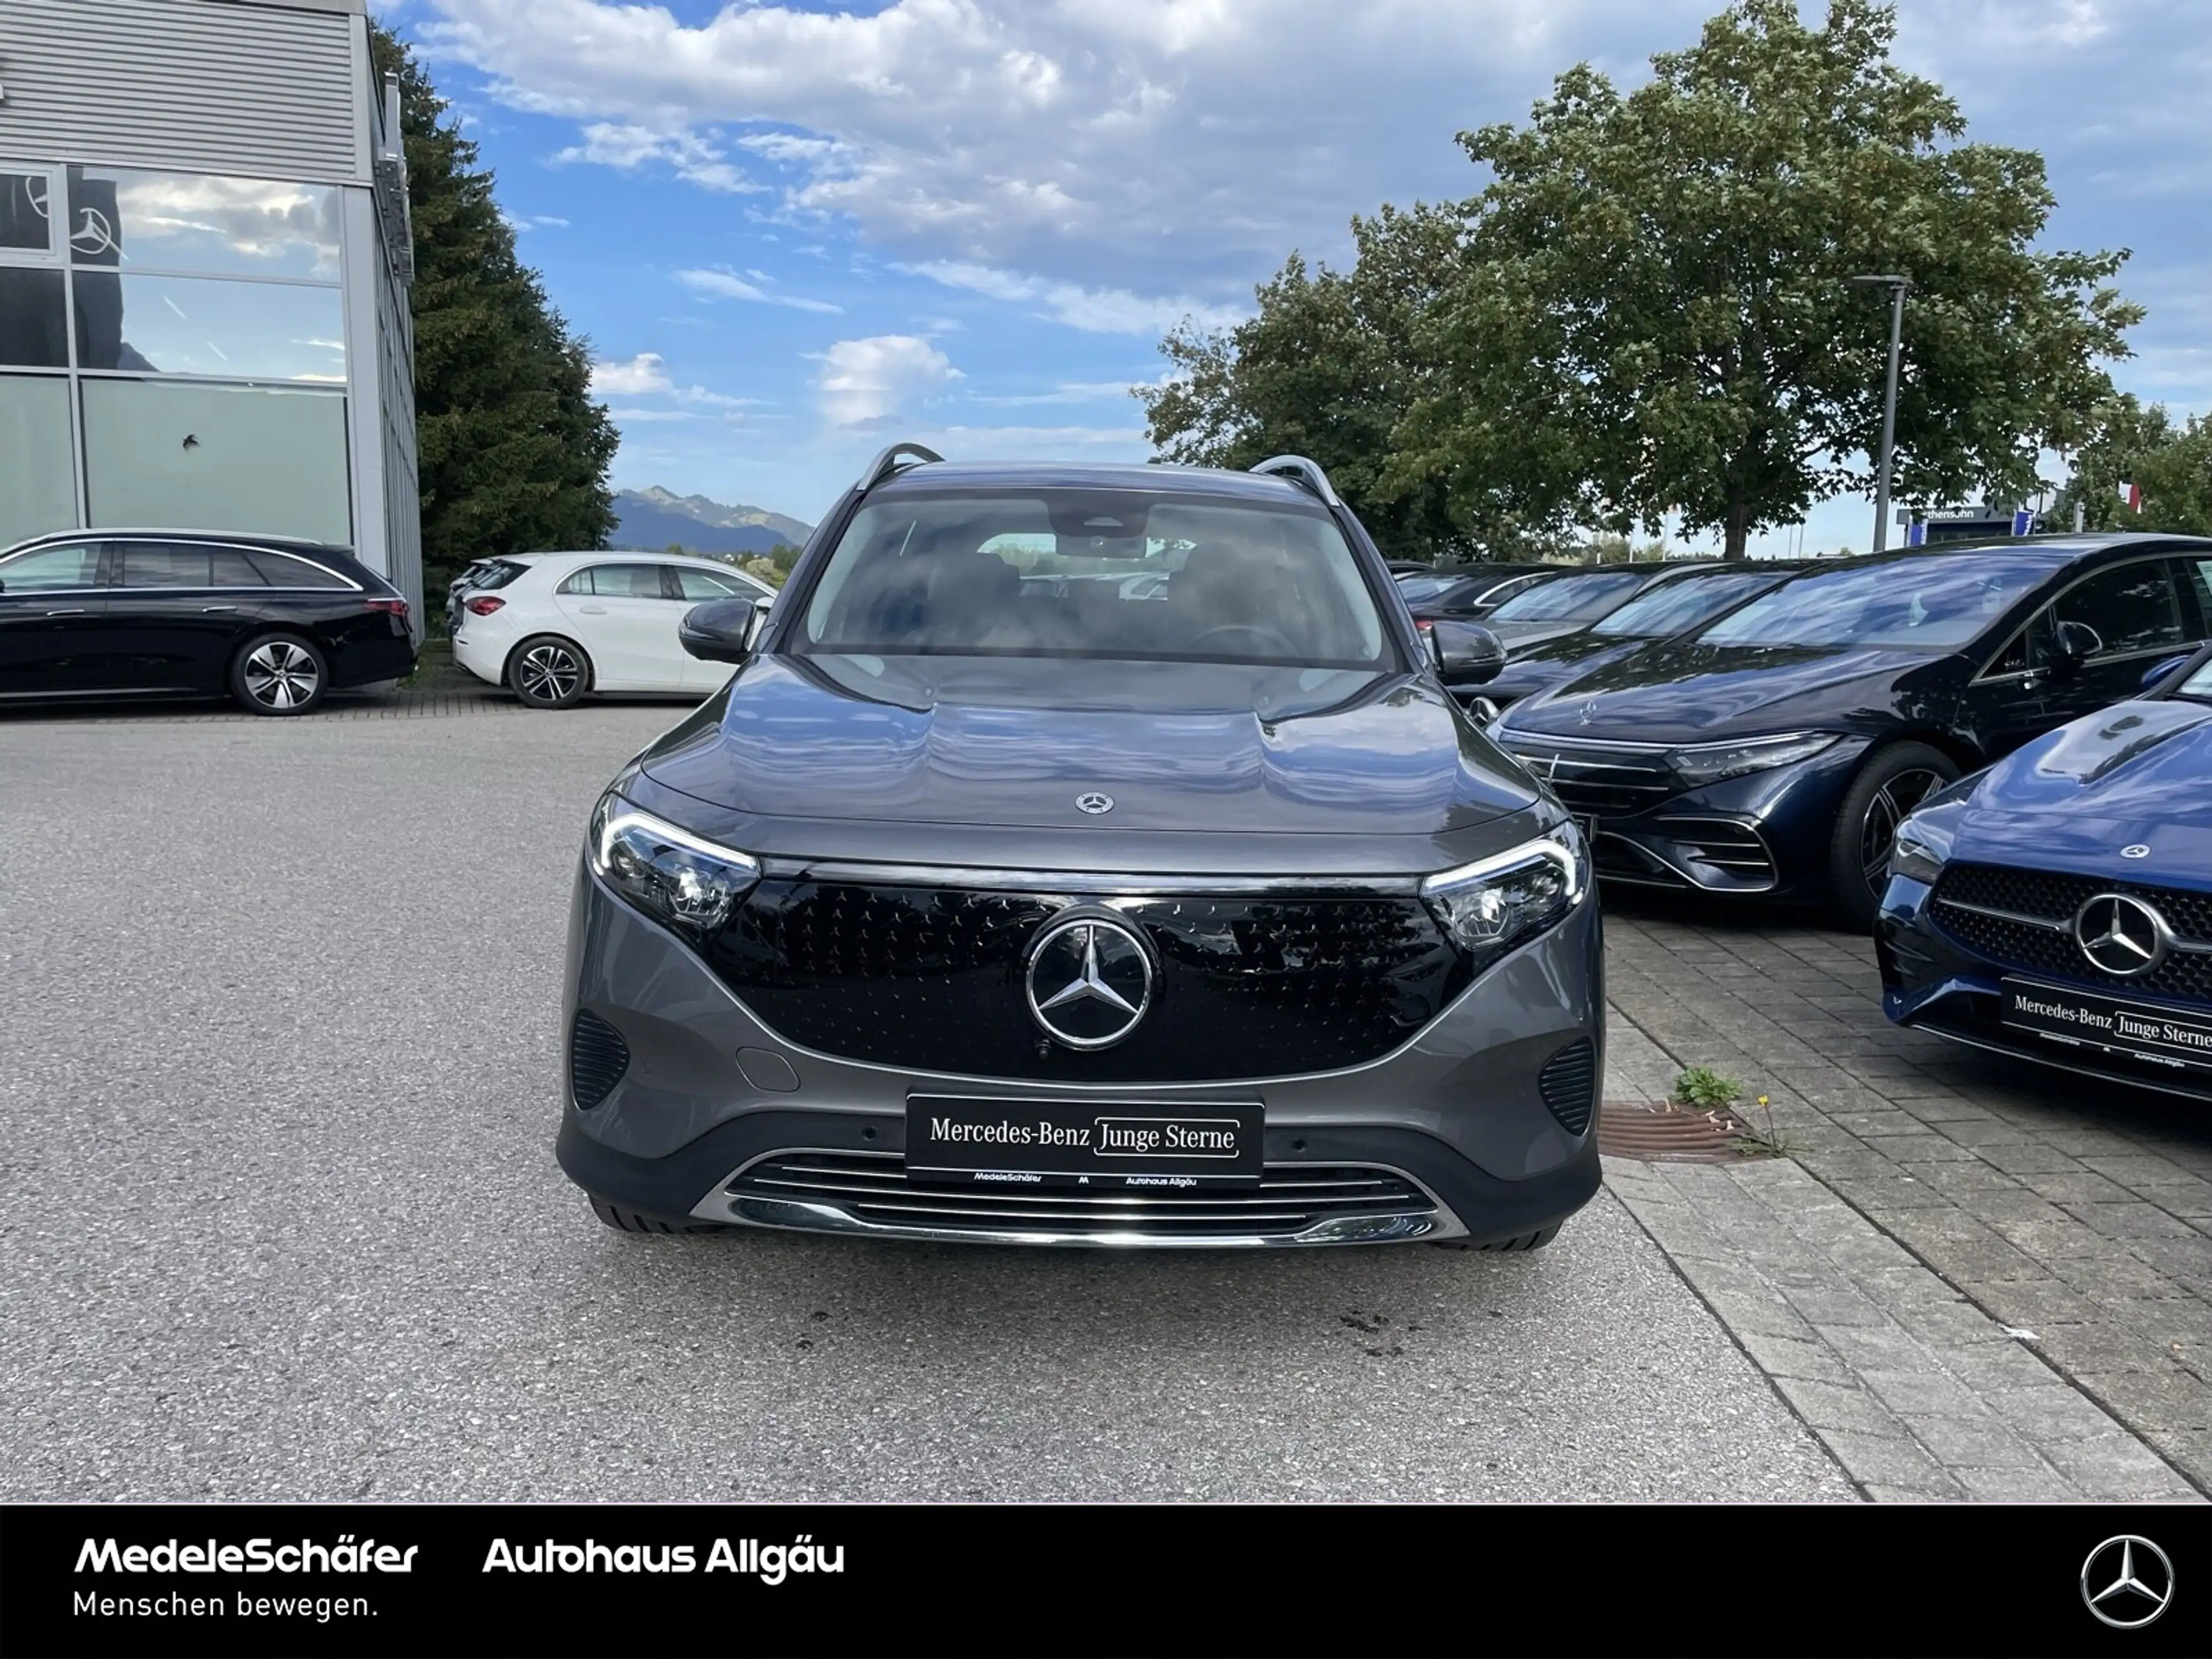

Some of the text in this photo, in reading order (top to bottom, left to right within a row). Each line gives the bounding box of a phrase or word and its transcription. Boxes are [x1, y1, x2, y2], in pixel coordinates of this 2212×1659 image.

[2015, 995, 2212, 1048] Mercedes-Benz Junge Sterne
[930, 1118, 1234, 1152] Mercedes-Benz Junge Sterne
[1126, 1177, 1168, 1185] Autohaus
[1168, 1177, 1197, 1188] Allgäu
